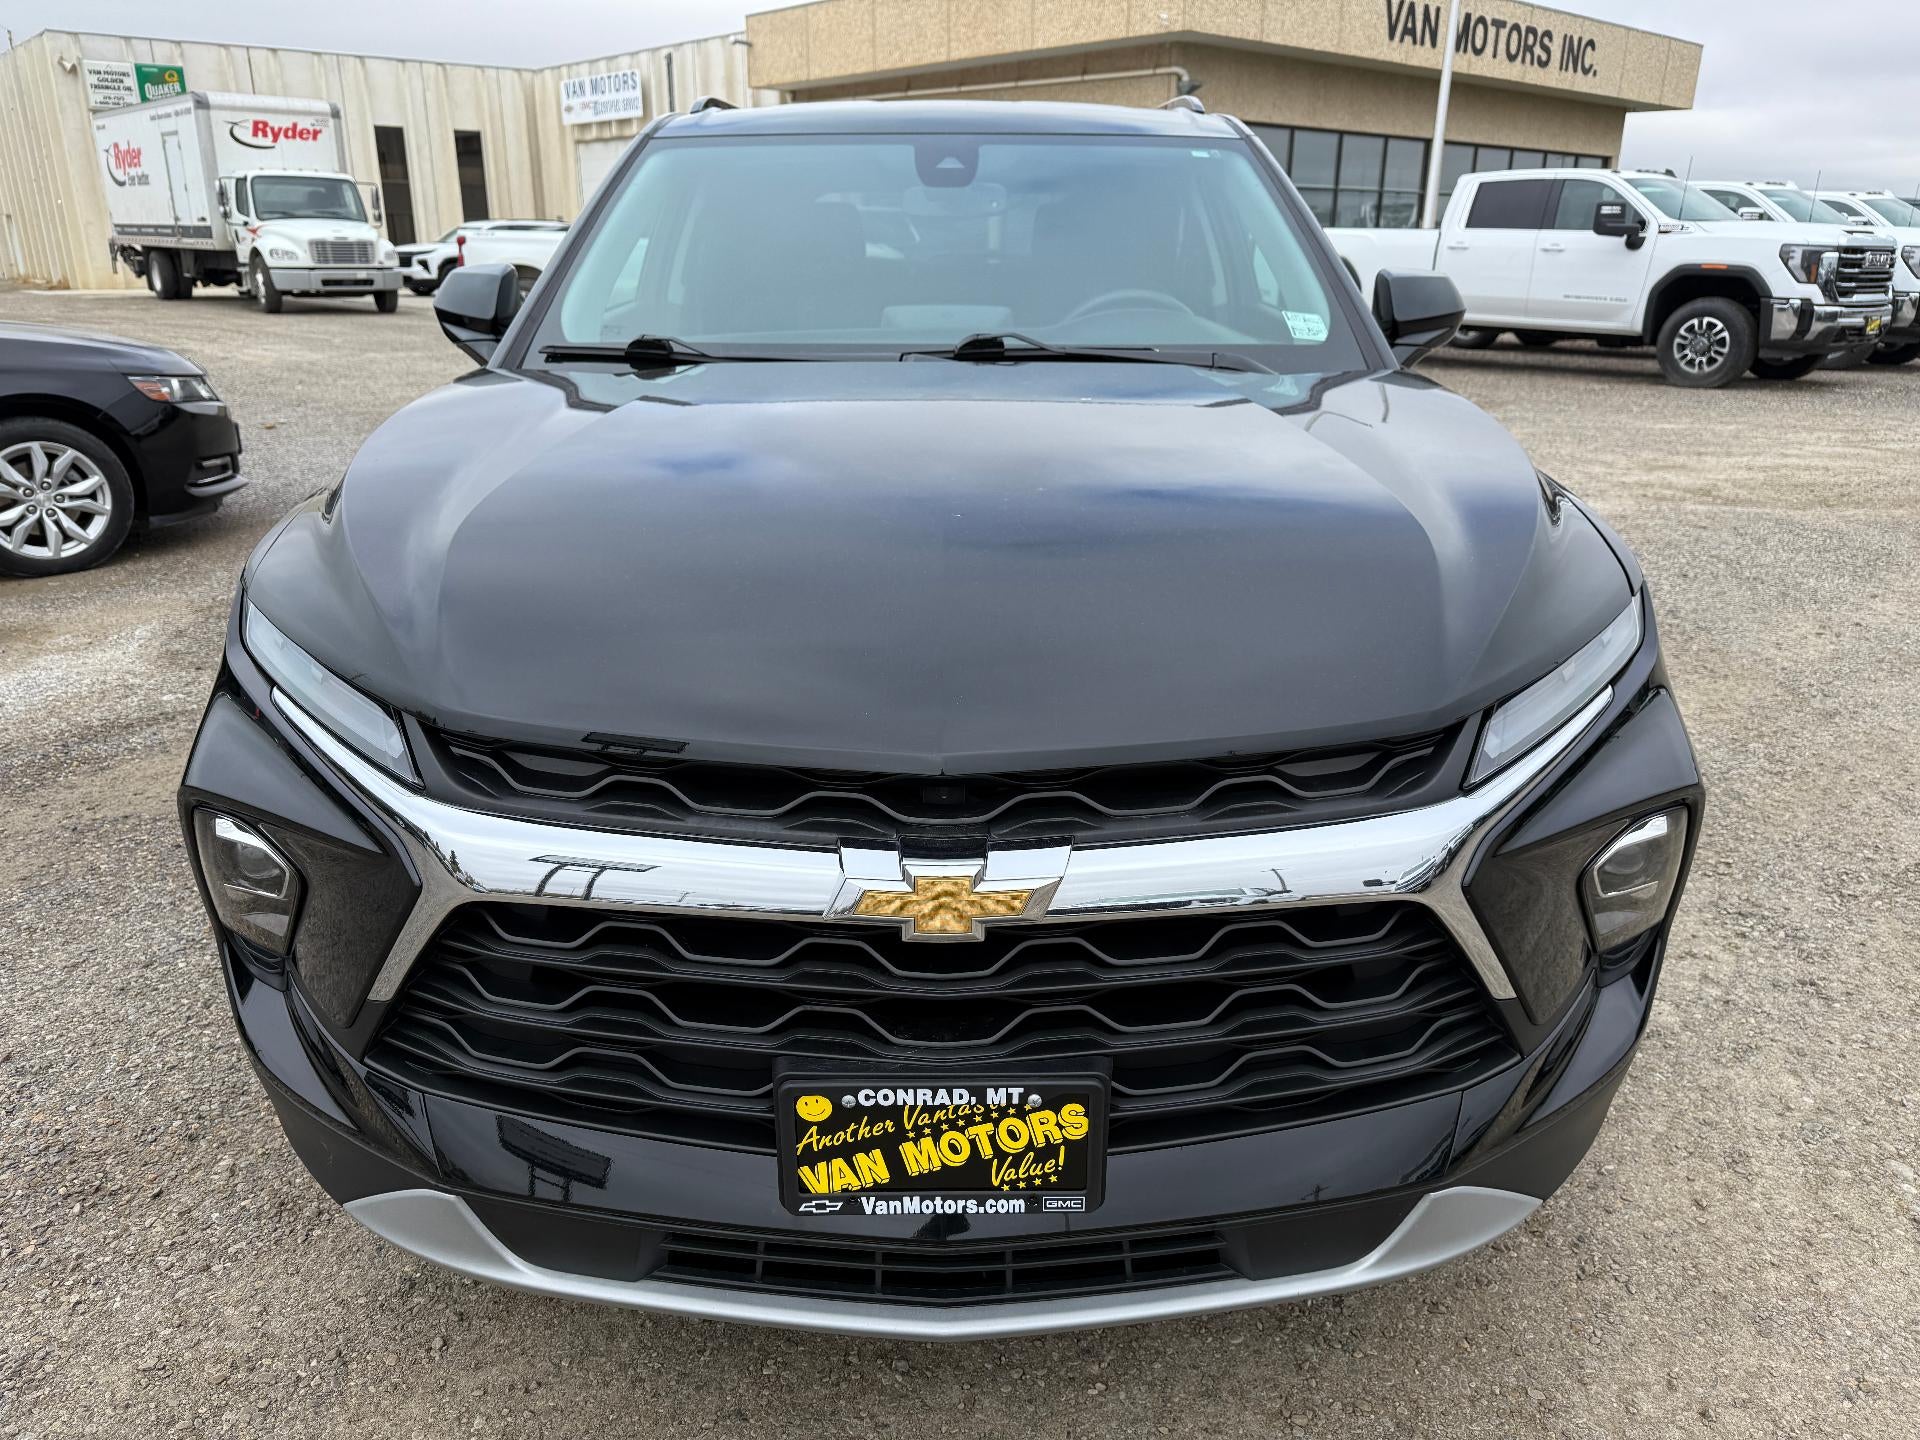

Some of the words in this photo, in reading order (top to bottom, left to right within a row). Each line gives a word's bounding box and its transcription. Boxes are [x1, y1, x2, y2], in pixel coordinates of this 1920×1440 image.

[1386, 0, 1441, 49] VAN
[1559, 33, 1598, 77] INC.
[103, 70, 130, 78] MOTORS
[564, 79, 586, 99] VAN
[590, 71, 638, 96] MOTORS
[144, 82, 182, 99] QUAKER
[252, 119, 322, 143] Ryder
[113, 140, 142, 176] Ryder
[857, 1088, 976, 1106] CONRAD,
[986, 1087, 1024, 1105] MT
[796, 1119, 896, 1156] Another
[797, 1149, 890, 1194] VAN
[899, 1103, 1089, 1177] MOTORS
[991, 1145, 1066, 1187] Value!
[860, 1196, 1025, 1215] VanMotors.com
[1045, 1200, 1082, 1208] GMC
